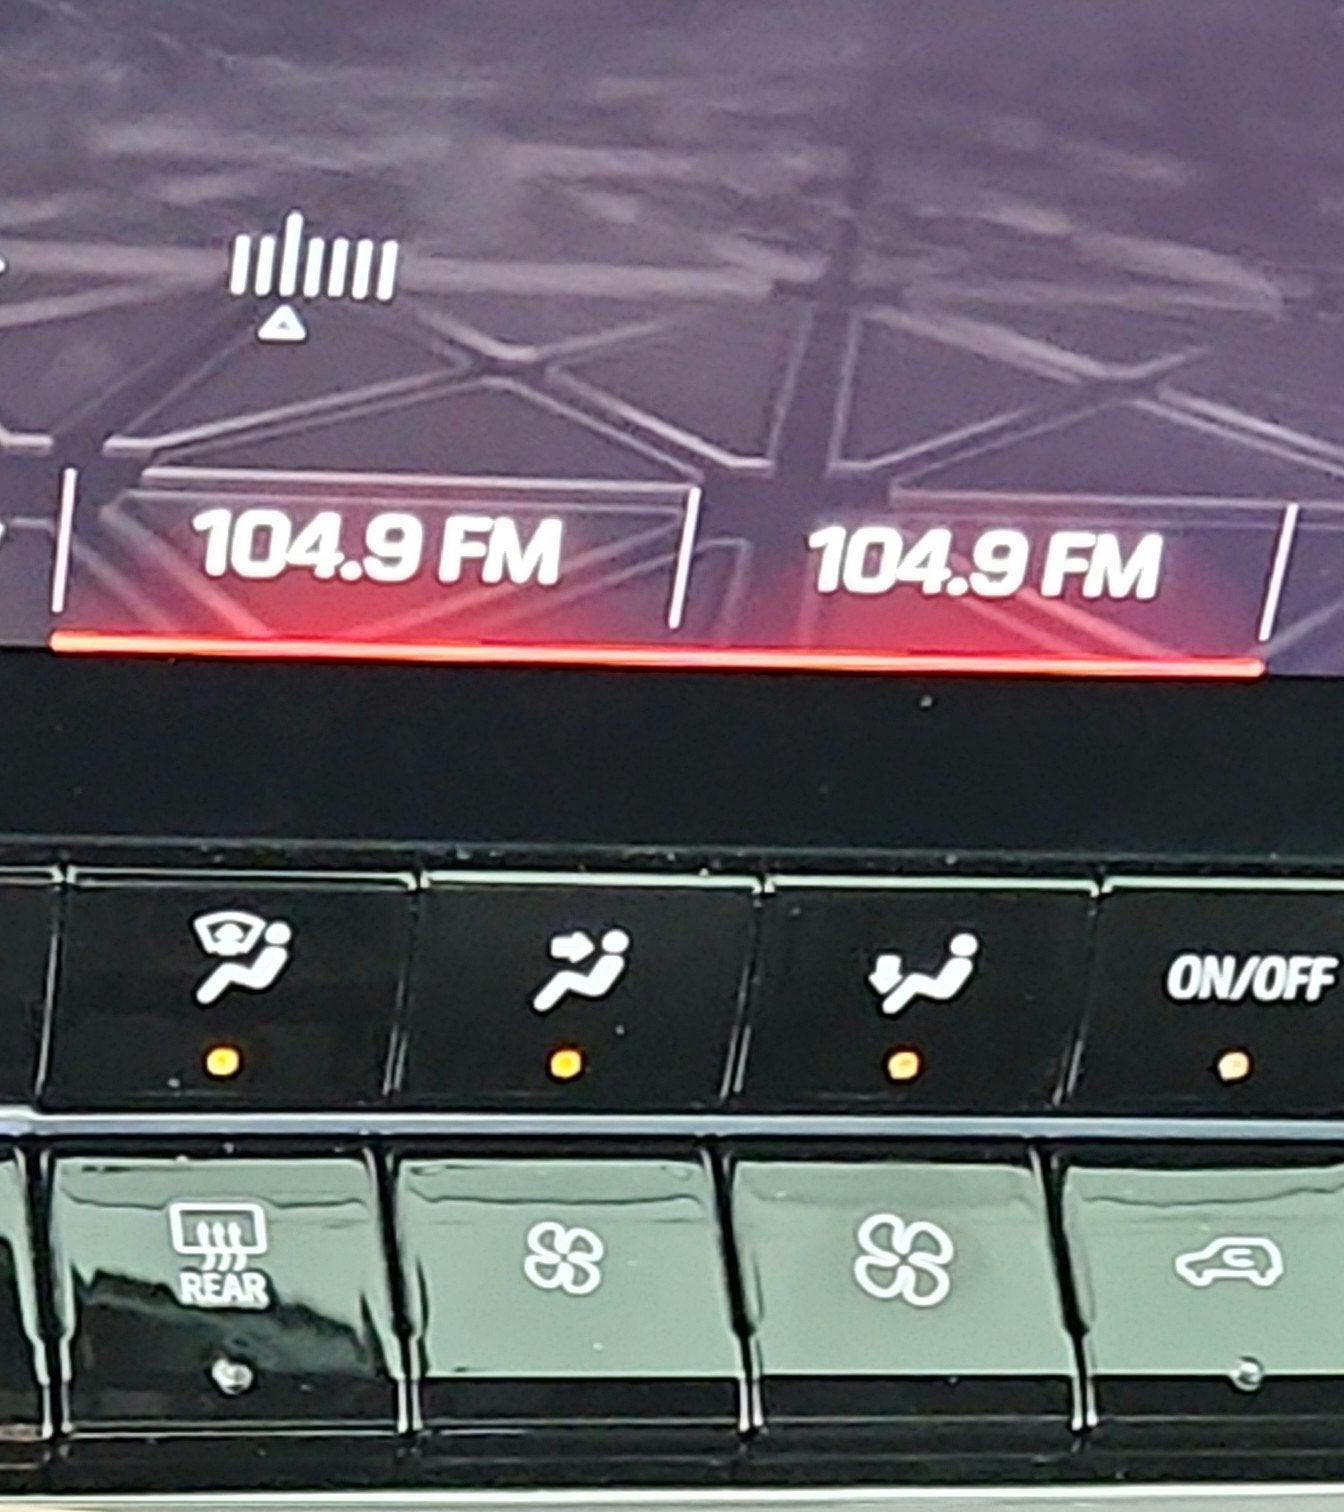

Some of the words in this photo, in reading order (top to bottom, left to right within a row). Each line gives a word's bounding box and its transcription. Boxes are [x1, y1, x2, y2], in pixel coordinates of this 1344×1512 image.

[191, 507, 420, 583] 104.9
[438, 514, 564, 587] FM
[806, 524, 1022, 598] 104.9
[1039, 529, 1166, 601] FM
[1165, 952, 1341, 1004] ON/OFF
[178, 1270, 268, 1308] REAR
